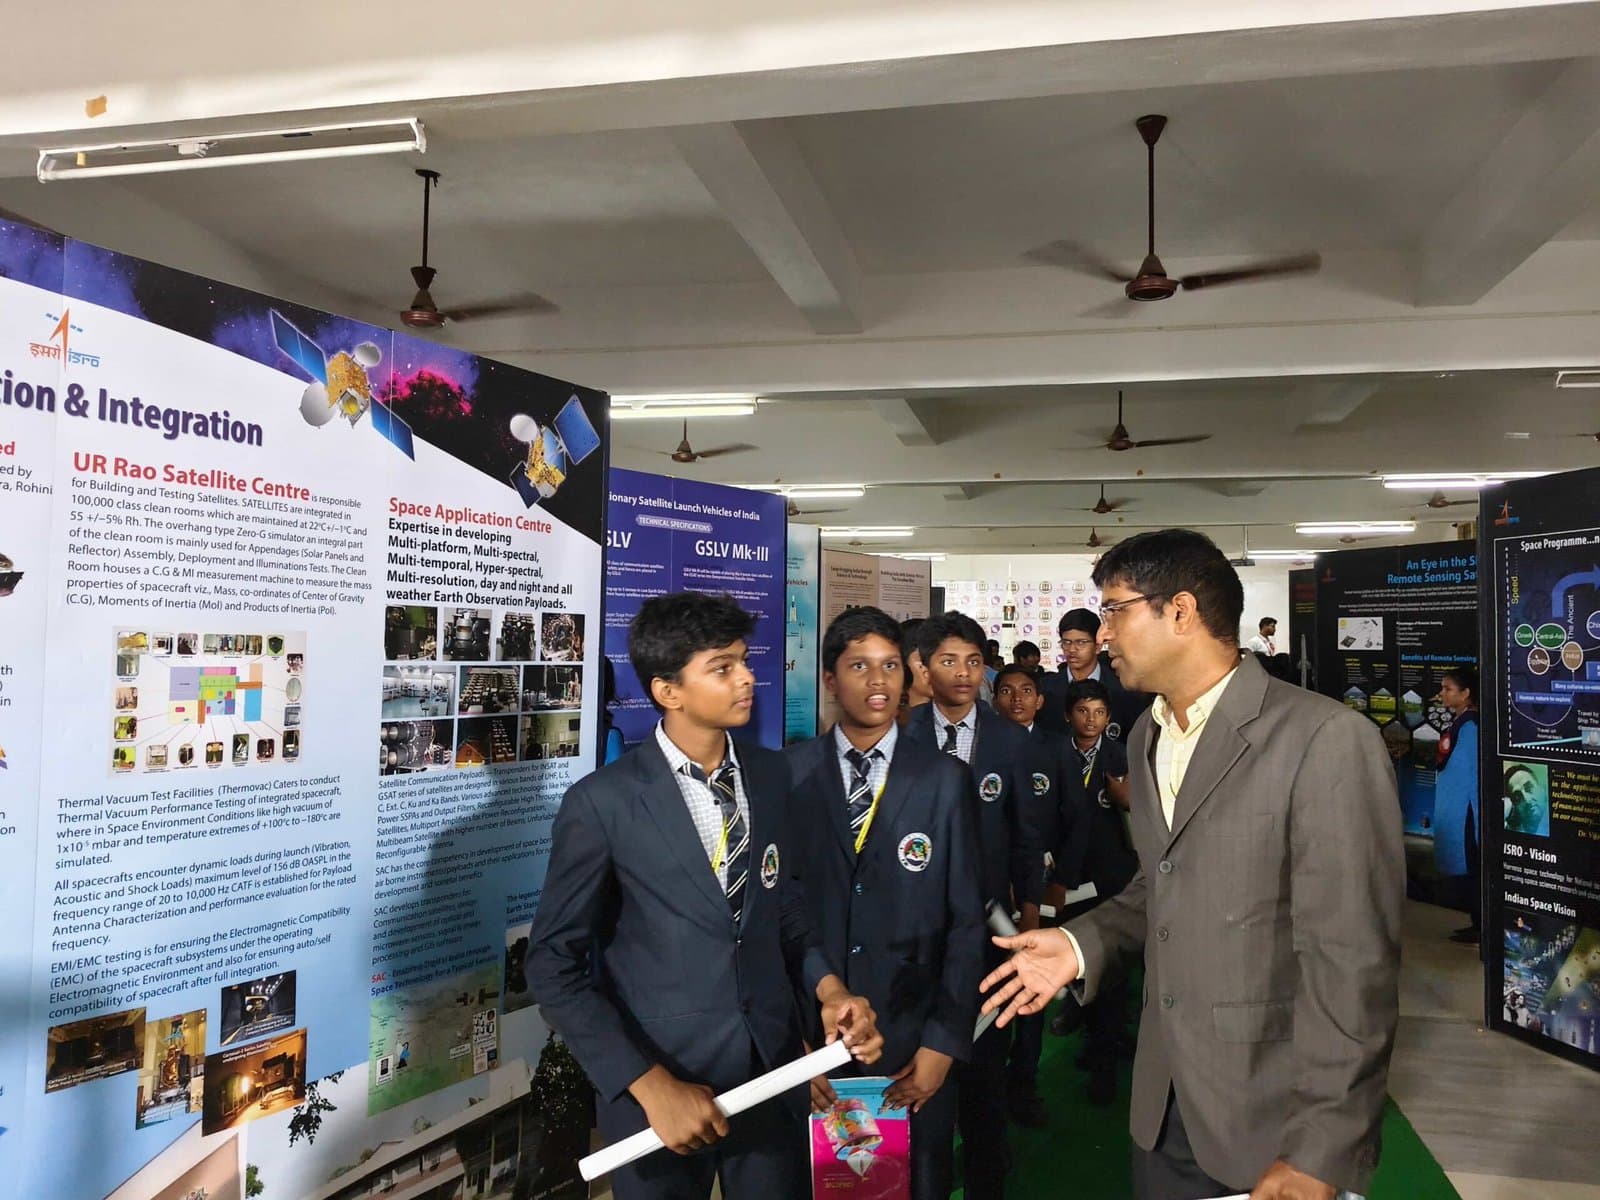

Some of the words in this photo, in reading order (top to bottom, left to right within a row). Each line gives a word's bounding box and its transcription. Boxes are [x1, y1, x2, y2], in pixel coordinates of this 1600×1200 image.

[29, 342, 60, 360] इसरो
[68, 348, 100, 368] isro
[0, 369, 55, 412] ion
[64, 383, 89, 418] &
[98, 388, 263, 446] Integration
[18, 465, 32, 479] by
[74, 452, 106, 474] UR
[113, 457, 156, 480] Rao
[163, 464, 247, 492] Satellite
[251, 477, 310, 500] Centre
[16, 480, 53, 495] Rohini
[71, 476, 87, 488] for
[89, 478, 134, 496] Building
[136, 486, 157, 496] and
[158, 487, 195, 503] Testing
[196, 491, 240, 506] Satellites.
[242, 498, 289, 513] SATELLITES
[304, 507, 343, 519] integrated
[319, 496, 362, 508] responsible
[638, 496, 672, 509] Satellite
[674, 501, 701, 513] Launch
[703, 505, 732, 518] Vehicles
[733, 509, 742, 518] of
[742, 511, 760, 521] India
[389, 496, 431, 518] Space
[434, 504, 513, 528] Application
[515, 516, 552, 533] Centre
[639, 516, 669, 527] TECHNICAL
[670, 520, 711, 531] SPECIFICATIONS
[388, 517, 439, 535] Expertise
[442, 525, 452, 537] in
[456, 526, 512, 546] developing
[388, 535, 471, 557] Multi-platform,
[474, 545, 539, 563] Multi-spectral,
[695, 539, 729, 558] GSLV
[732, 543, 769, 562] Mk-III
[1520, 540, 1542, 552] Space
[68, 542, 121, 558] Reflector)
[122, 547, 176, 563] Assembly,
[177, 551, 236, 566] Deployment
[236, 557, 254, 567] and
[255, 558, 308, 571] Illuminations
[308, 562, 330, 573] Tests.
[330, 564, 345, 574] The
[345, 565, 367, 576] Clean
[387, 552, 473, 572] Multi-temporal,
[475, 563, 544, 579] Hyper-spectral,
[1406, 560, 1419, 571] An
[1421, 559, 1437, 571] Eye
[1440, 557, 1449, 568] in
[1451, 556, 1466, 567] the
[387, 570, 478, 590] Multi-resolution,
[480, 578, 498, 591] day
[500, 580, 517, 591] and
[519, 581, 541, 595] night
[542, 583, 559, 594] and
[561, 584, 572, 595] all
[1387, 574, 1422, 584] Remote
[1424, 571, 1461, 583] Sensing
[97, 594, 150, 607] Moments
[151, 596, 163, 607] of
[164, 597, 197, 608] Inertia
[224, 600, 242, 610] and
[242, 601, 280, 612] Products
[280, 603, 290, 612] of
[290, 604, 316, 614] Inertia
[386, 588, 431, 601] weather
[434, 590, 463, 603] Earth
[466, 592, 522, 607] Observation
[525, 597, 566, 610] Payloads.
[57, 794, 104, 808] Thermal
[105, 793, 149, 804] Vacuum
[149, 790, 171, 800] Test
[172, 786, 214, 799] Facilities
[217, 780, 272, 796] (Thermovac)
[272, 779, 299, 789] Caters
[299, 778, 308, 787] to
[308, 774, 340, 785] conduct
[378, 778, 406, 789] Satellite
[408, 774, 458, 786] Communication
[378, 791, 397, 800] GSAT
[398, 790, 416, 798] series
[418, 787, 425, 795] of
[426, 785, 452, 795] satellites
[56, 809, 103, 824] Thermal
[104, 808, 148, 819] Vacuum
[150, 801, 213, 814] Performance
[214, 797, 246, 808] Testing
[246, 794, 257, 805] of
[257, 790, 301, 804] integrated
[300, 785, 342, 800] spacecraft,
[378, 816, 399, 824] Power
[421, 810, 433, 819] and
[434, 807, 456, 816] Output
[376, 845, 426, 860] Reconfigurable
[1503, 843, 1522, 857] ISRO
[1529, 848, 1557, 864] Vision
[53, 878, 69, 891] All
[71, 871, 134, 890] spacecrafts
[134, 865, 188, 880] encounter
[188, 858, 228, 874] dynamic
[229, 853, 253, 866] loads
[253, 850, 282, 862] during
[282, 844, 310, 857] launch
[310, 840, 351, 854] (Vibration,
[376, 866, 390, 876] SAC
[391, 864, 402, 873] has
[404, 862, 415, 870] the
[375, 883, 419, 899] development
[1504, 891, 1528, 906] Indian
[1530, 897, 1552, 912] Space
[1553, 902, 1576, 917] Vision
[371, 971, 387, 983] SAC
[48, 996, 124, 1018] compatibility
[124, 990, 137, 1003] of
[138, 979, 189, 1001] spacecraft
[190, 975, 213, 988] after
[213, 969, 228, 982] full
[229, 960, 280, 978] integration.
[371, 985, 393, 996] Space
